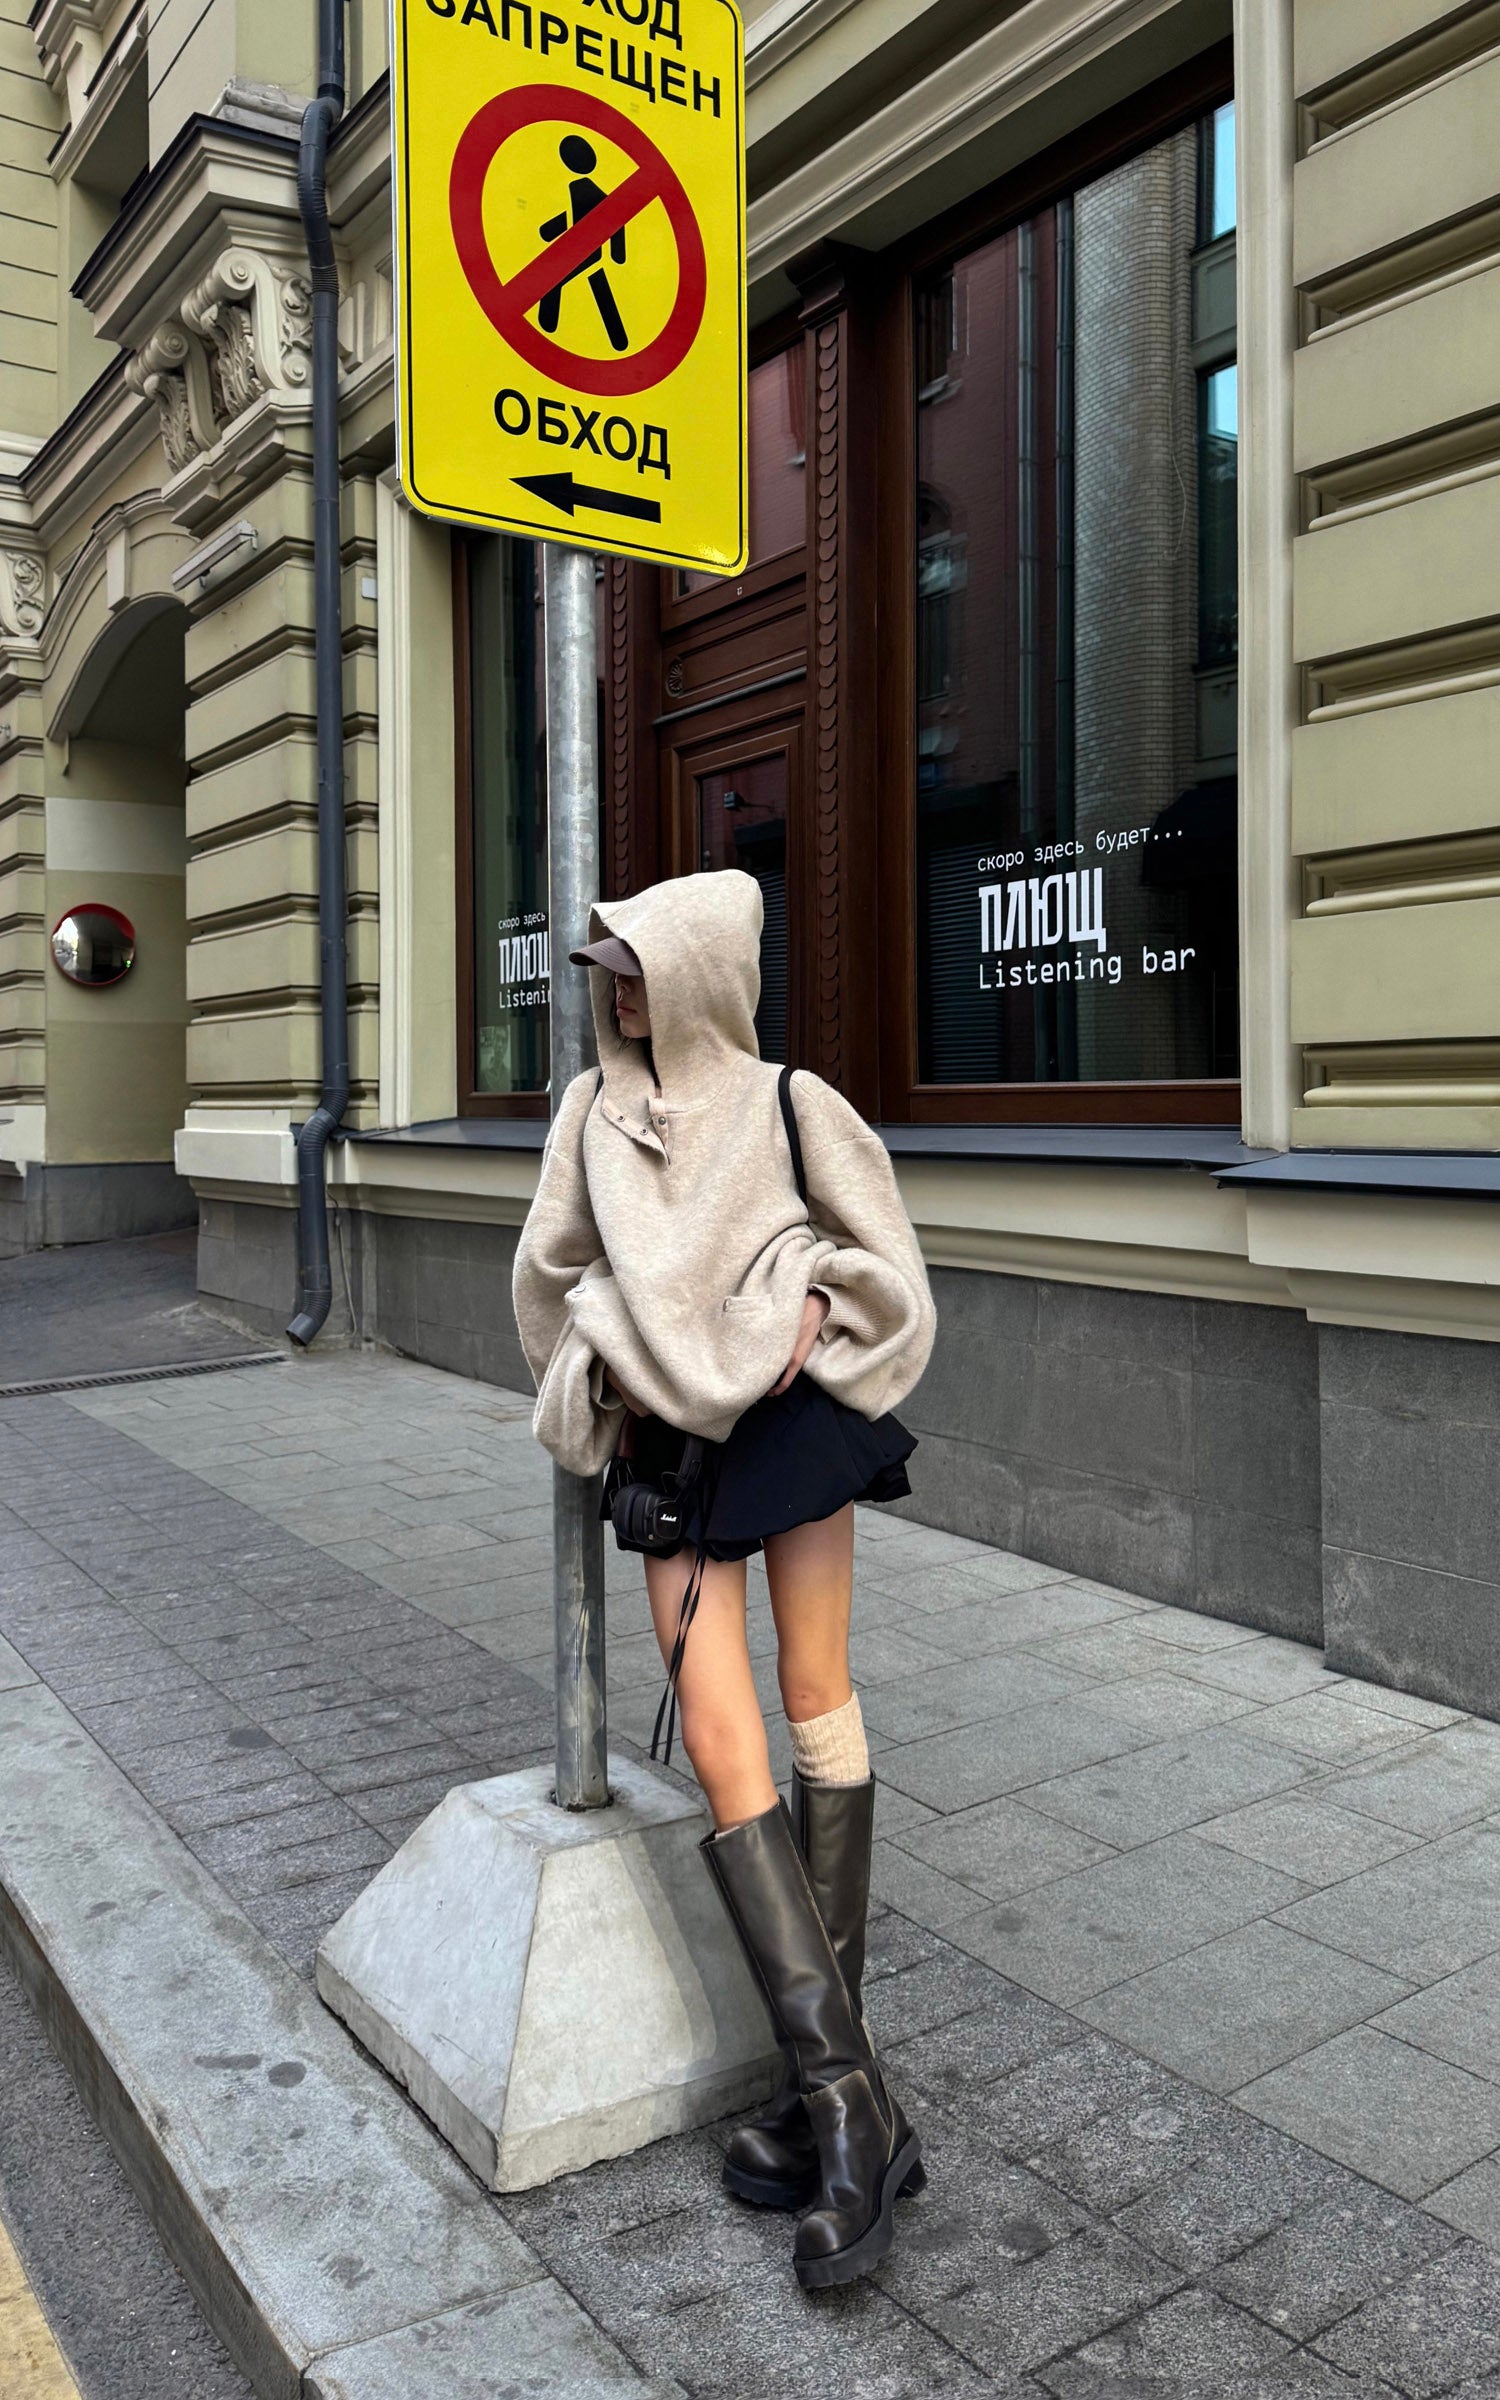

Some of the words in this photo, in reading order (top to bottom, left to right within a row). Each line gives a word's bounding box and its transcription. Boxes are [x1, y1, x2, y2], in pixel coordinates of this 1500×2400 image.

[493, 388, 671, 480] ОБХОД
[977, 850, 1025, 872] скоро
[1034, 840, 1085, 864] здесь
[1095, 827, 1183, 854] будет...
[498, 917, 520, 930] скоро
[523, 912, 546, 927] здесь
[978, 867, 1107, 953] ПЛЮЩ
[979, 951, 1122, 990] Listening
[1142, 946, 1196, 974] bar
